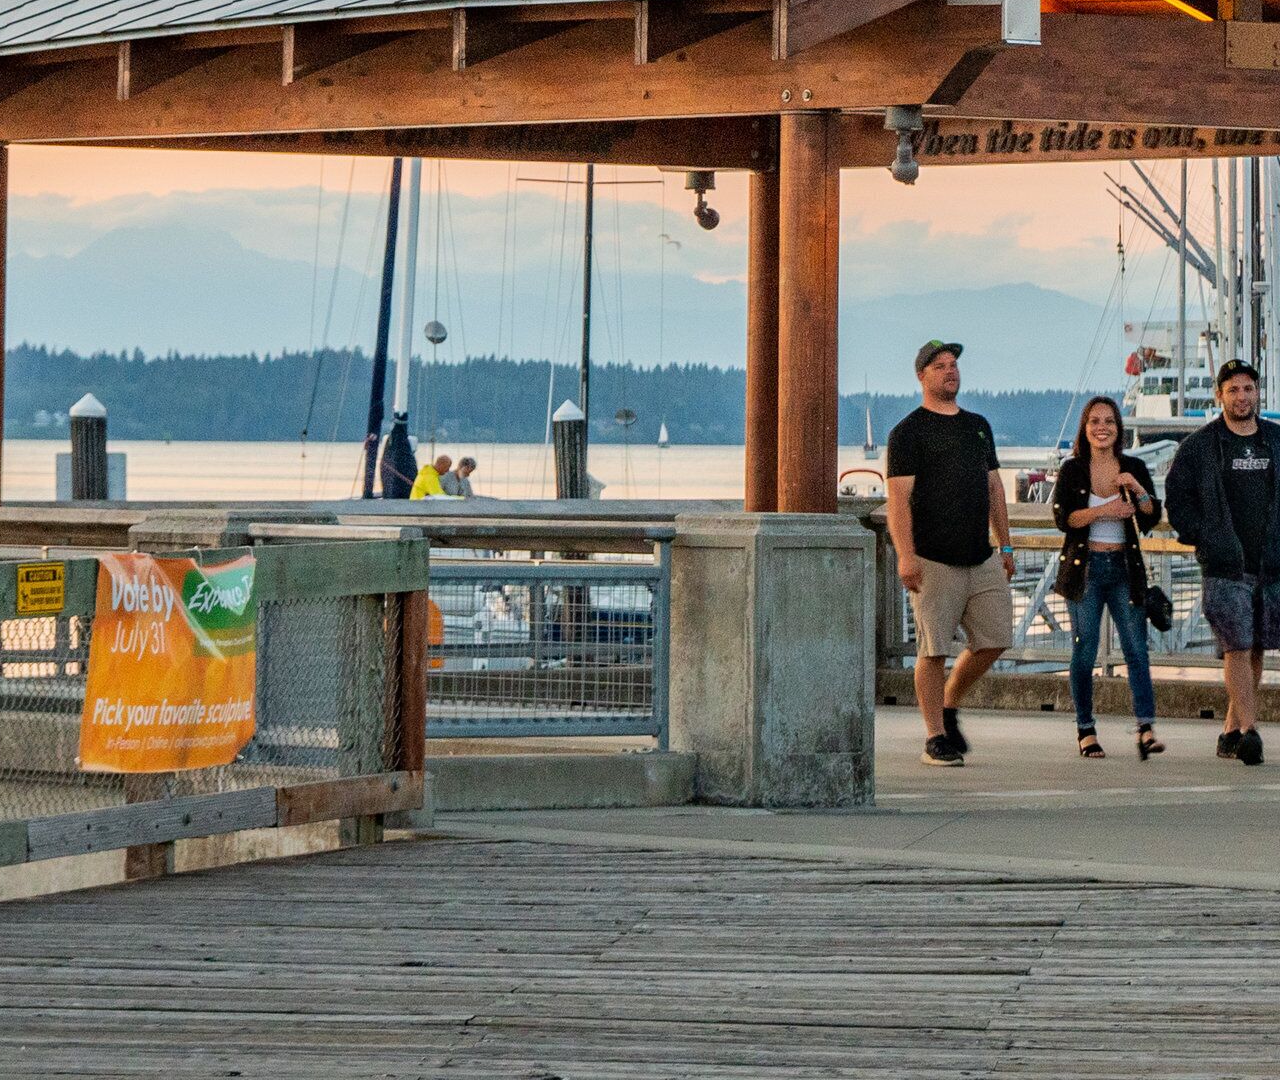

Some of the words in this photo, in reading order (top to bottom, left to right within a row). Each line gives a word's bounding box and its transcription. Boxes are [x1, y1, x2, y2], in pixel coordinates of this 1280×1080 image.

[985, 119, 1034, 153] the
[1039, 121, 1103, 152] tide
[112, 573, 149, 612] Vote
[151, 574, 174, 621] by
[111, 620, 149, 661] July
[151, 621, 165, 654] 31
[93, 698, 123, 725] Pick
[124, 704, 158, 732] your
[158, 698, 206, 725] favorite
